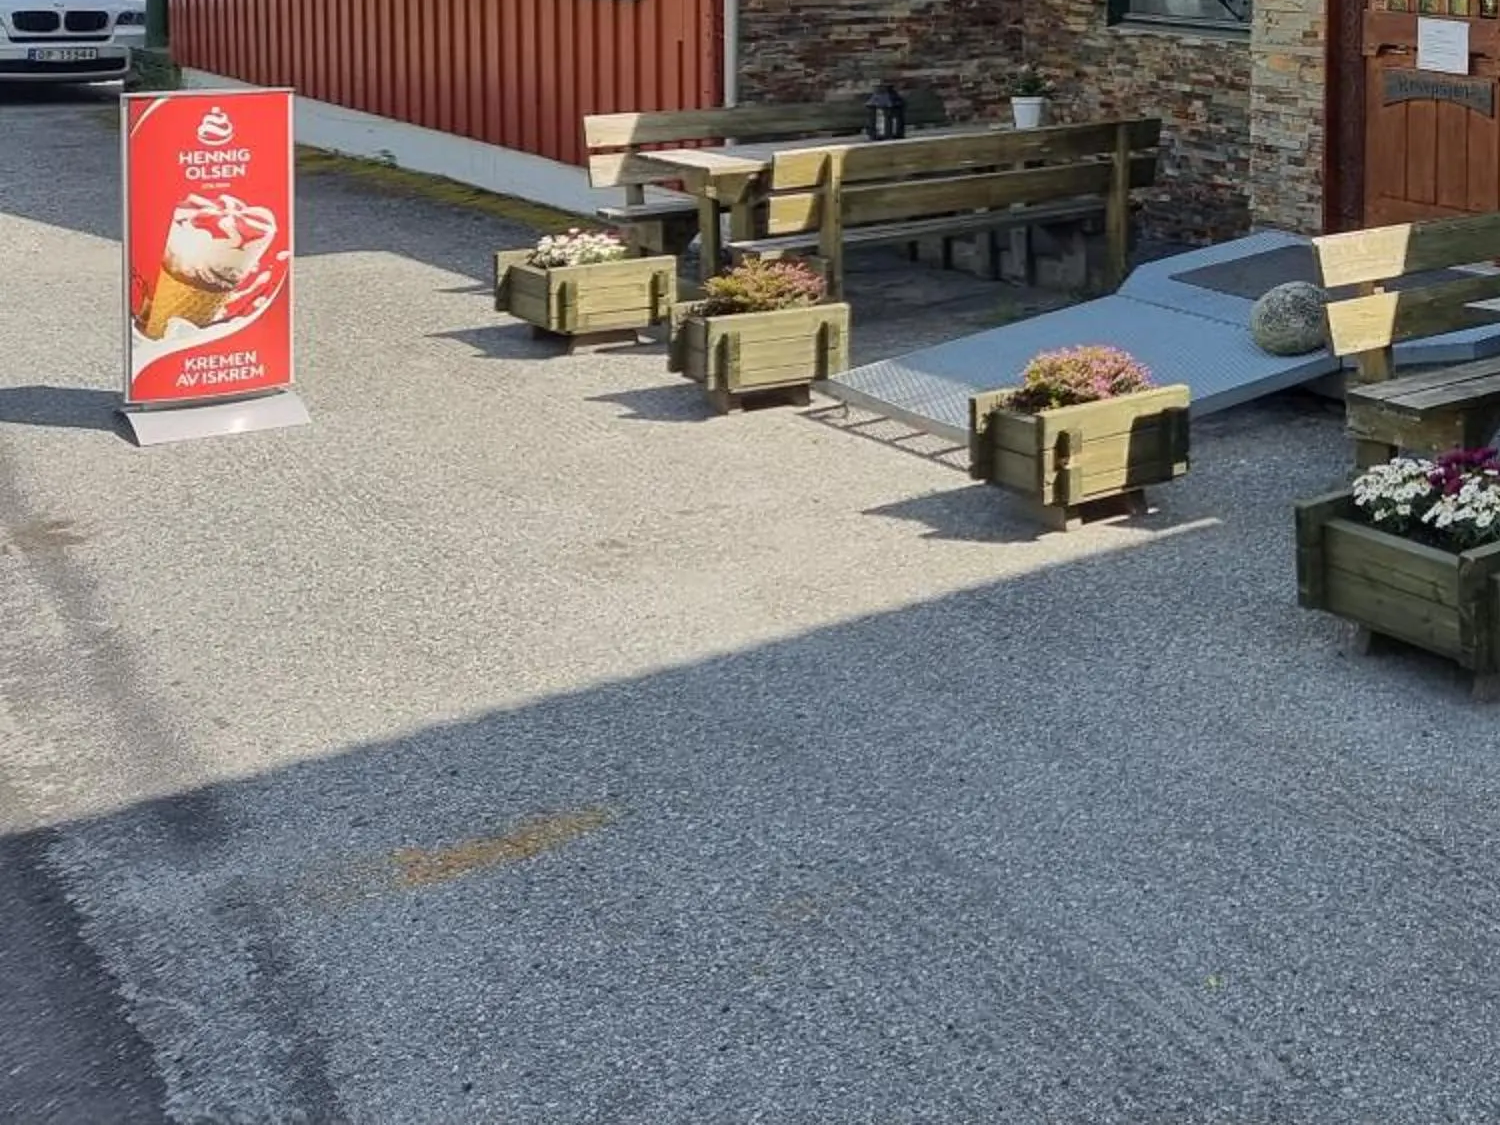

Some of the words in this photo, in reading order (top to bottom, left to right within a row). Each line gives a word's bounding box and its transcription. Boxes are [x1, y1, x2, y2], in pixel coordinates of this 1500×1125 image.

[179, 148, 252, 164] HENNIG
[185, 164, 246, 180] OLSEN
[184, 351, 257, 372] KREMEN
[175, 373, 199, 387] AV
[202, 364, 265, 384] ISKREM
